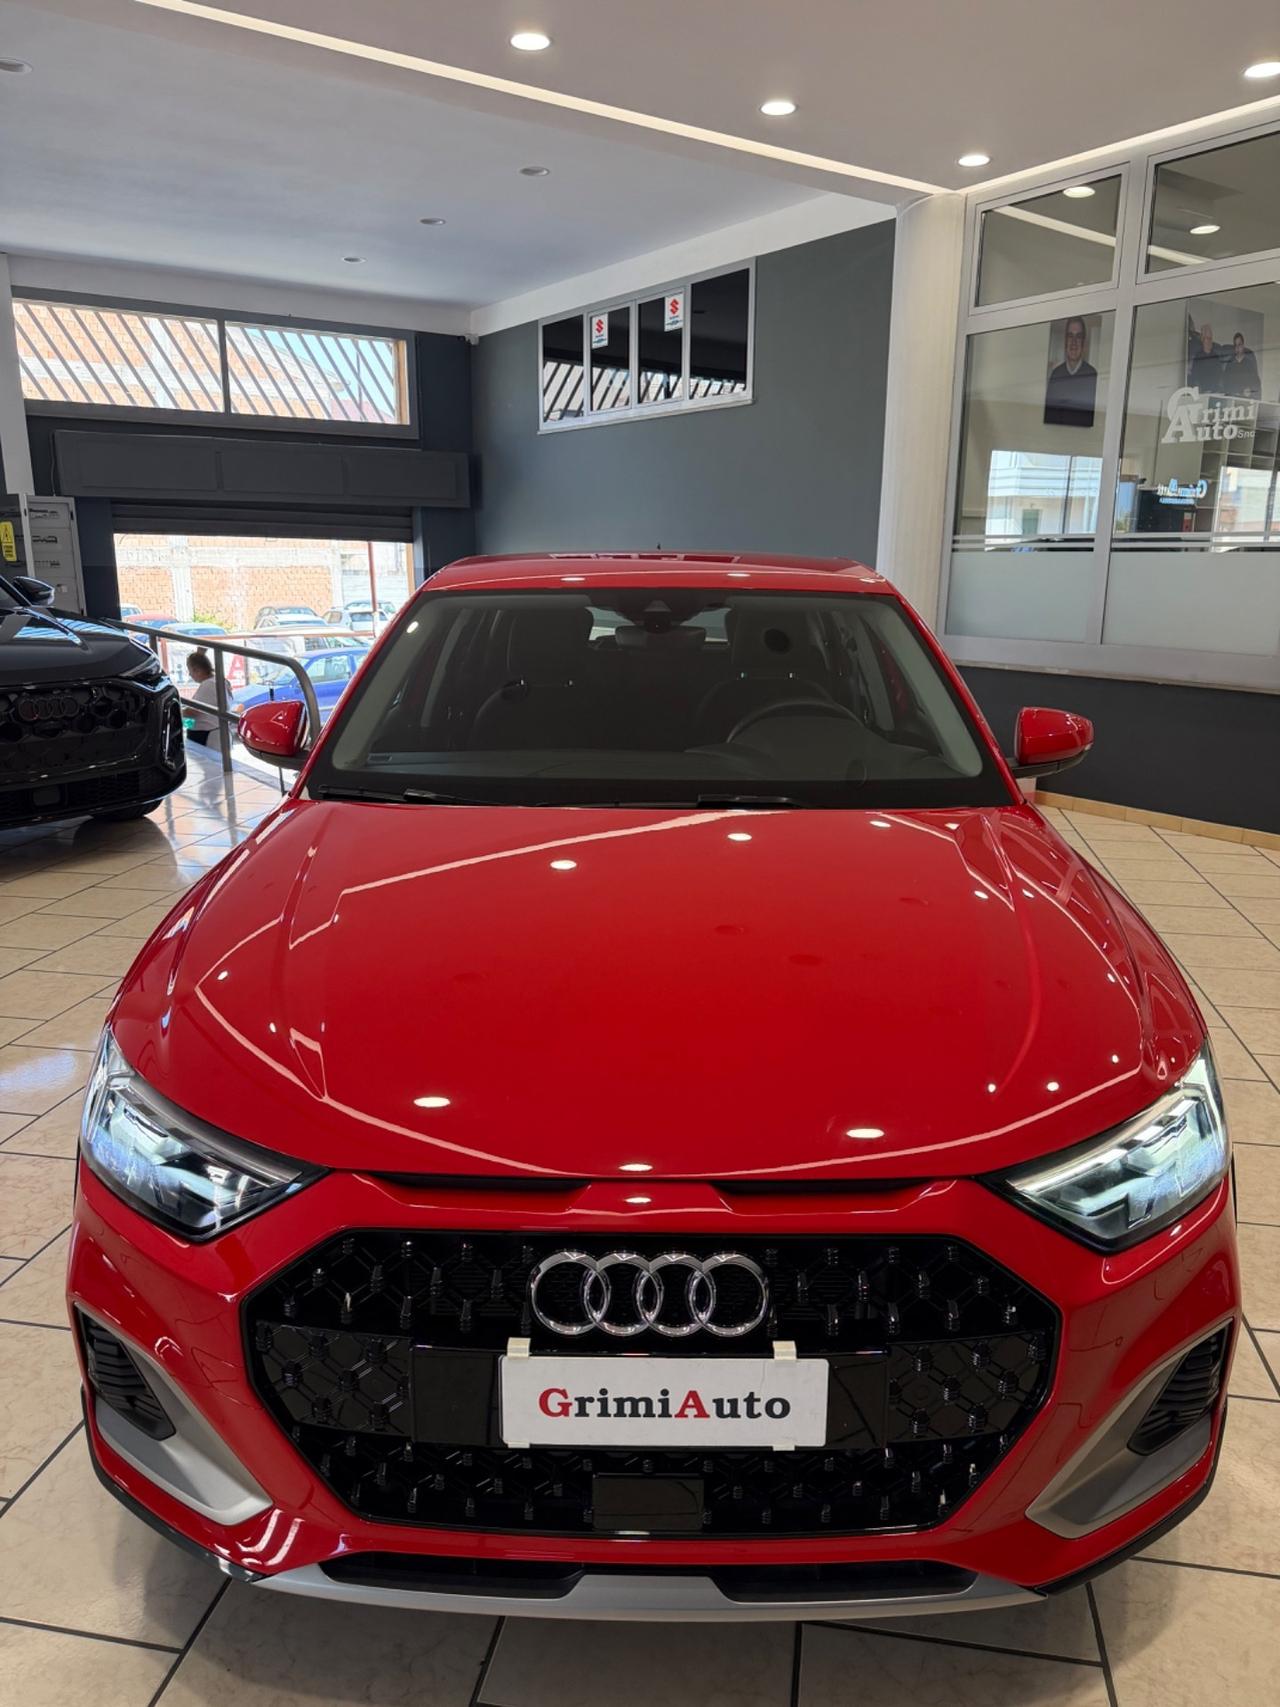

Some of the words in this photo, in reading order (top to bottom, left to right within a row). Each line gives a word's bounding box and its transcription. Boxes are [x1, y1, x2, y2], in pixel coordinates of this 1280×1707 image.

[1161, 405, 1238, 443] Auto
[1168, 387, 1256, 424] Grimi
[538, 1387, 791, 1418] GrimiAuto
